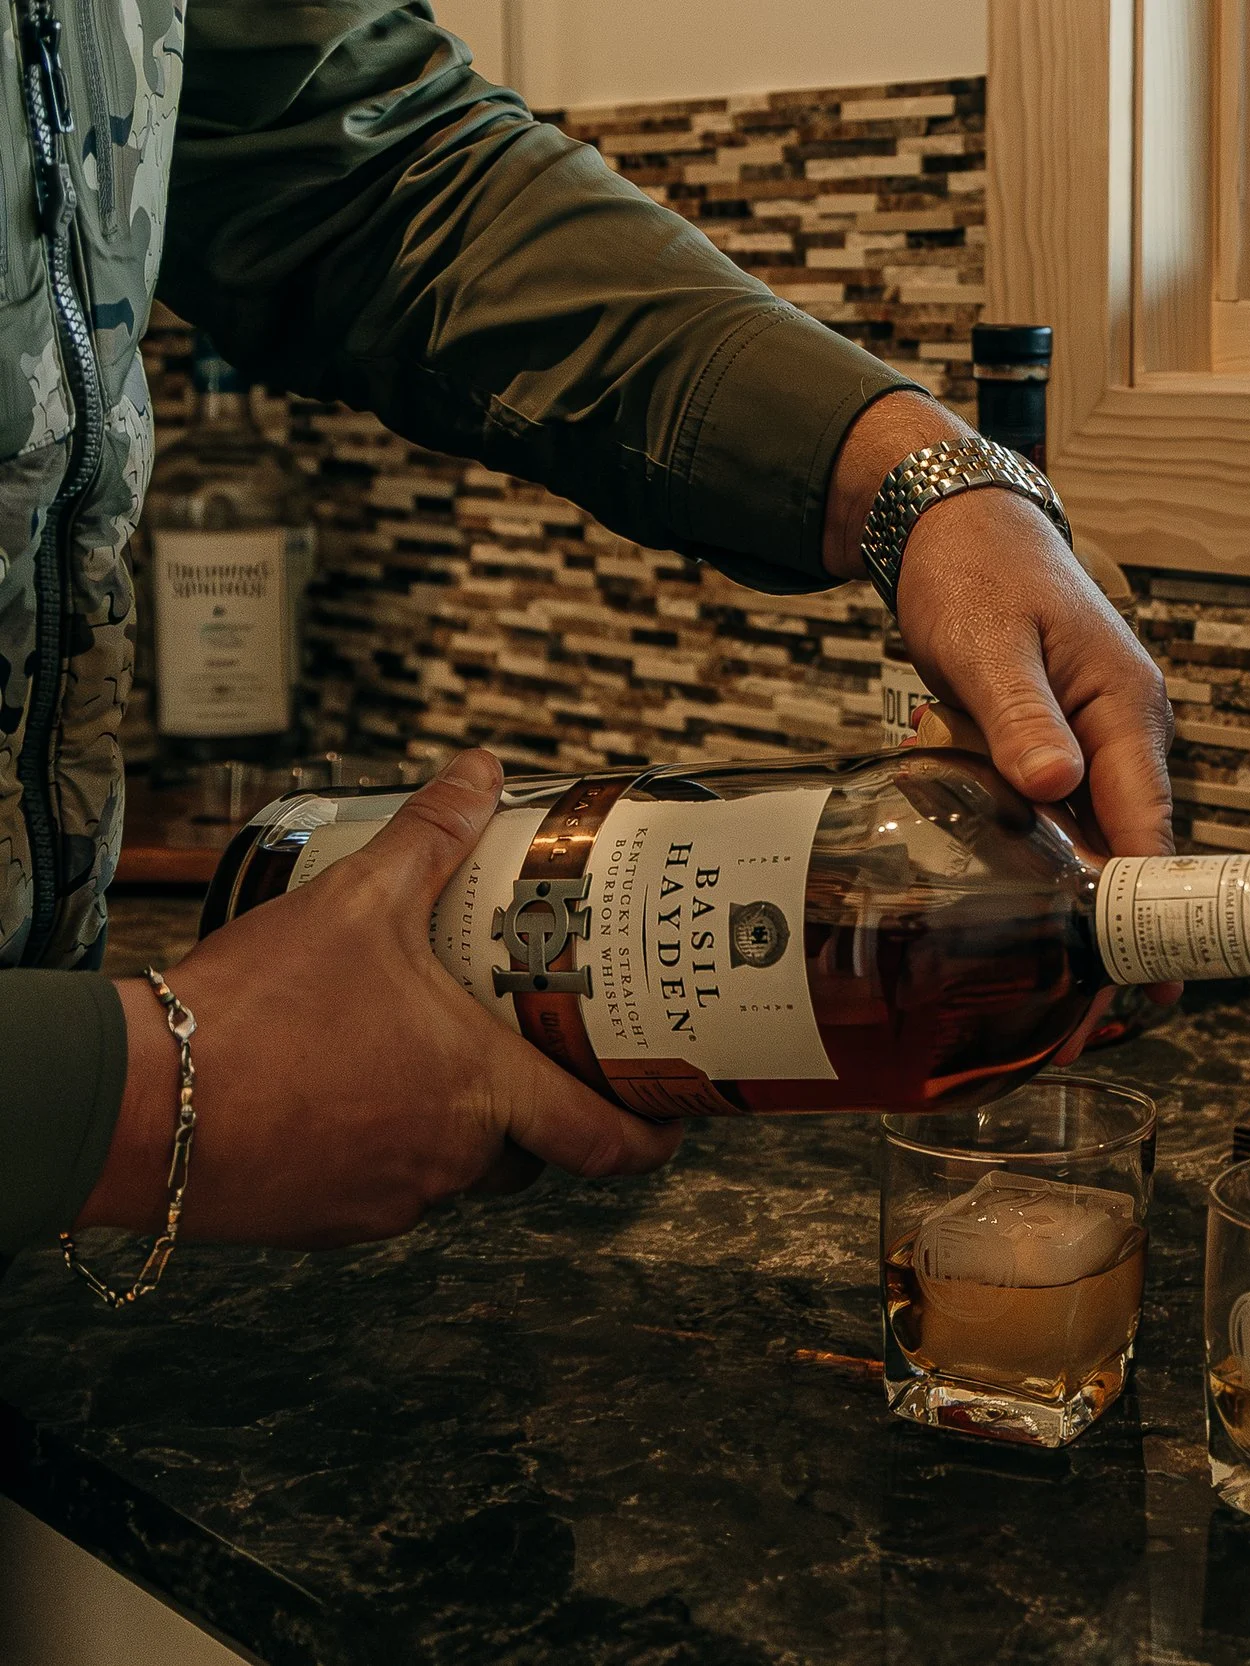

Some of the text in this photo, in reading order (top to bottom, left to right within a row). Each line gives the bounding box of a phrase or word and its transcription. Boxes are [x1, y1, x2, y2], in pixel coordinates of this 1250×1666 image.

[549, 788, 601, 860] BASIL
[737, 855, 791, 866] SMALL
[460, 862, 482, 966] ARTFULLY
[601, 839, 627, 1039] BOURBON WHISKEY
[618, 827, 649, 1049] KENTUCKY STRAIGHT
[656, 841, 721, 1033] BASIL HAYDEN
